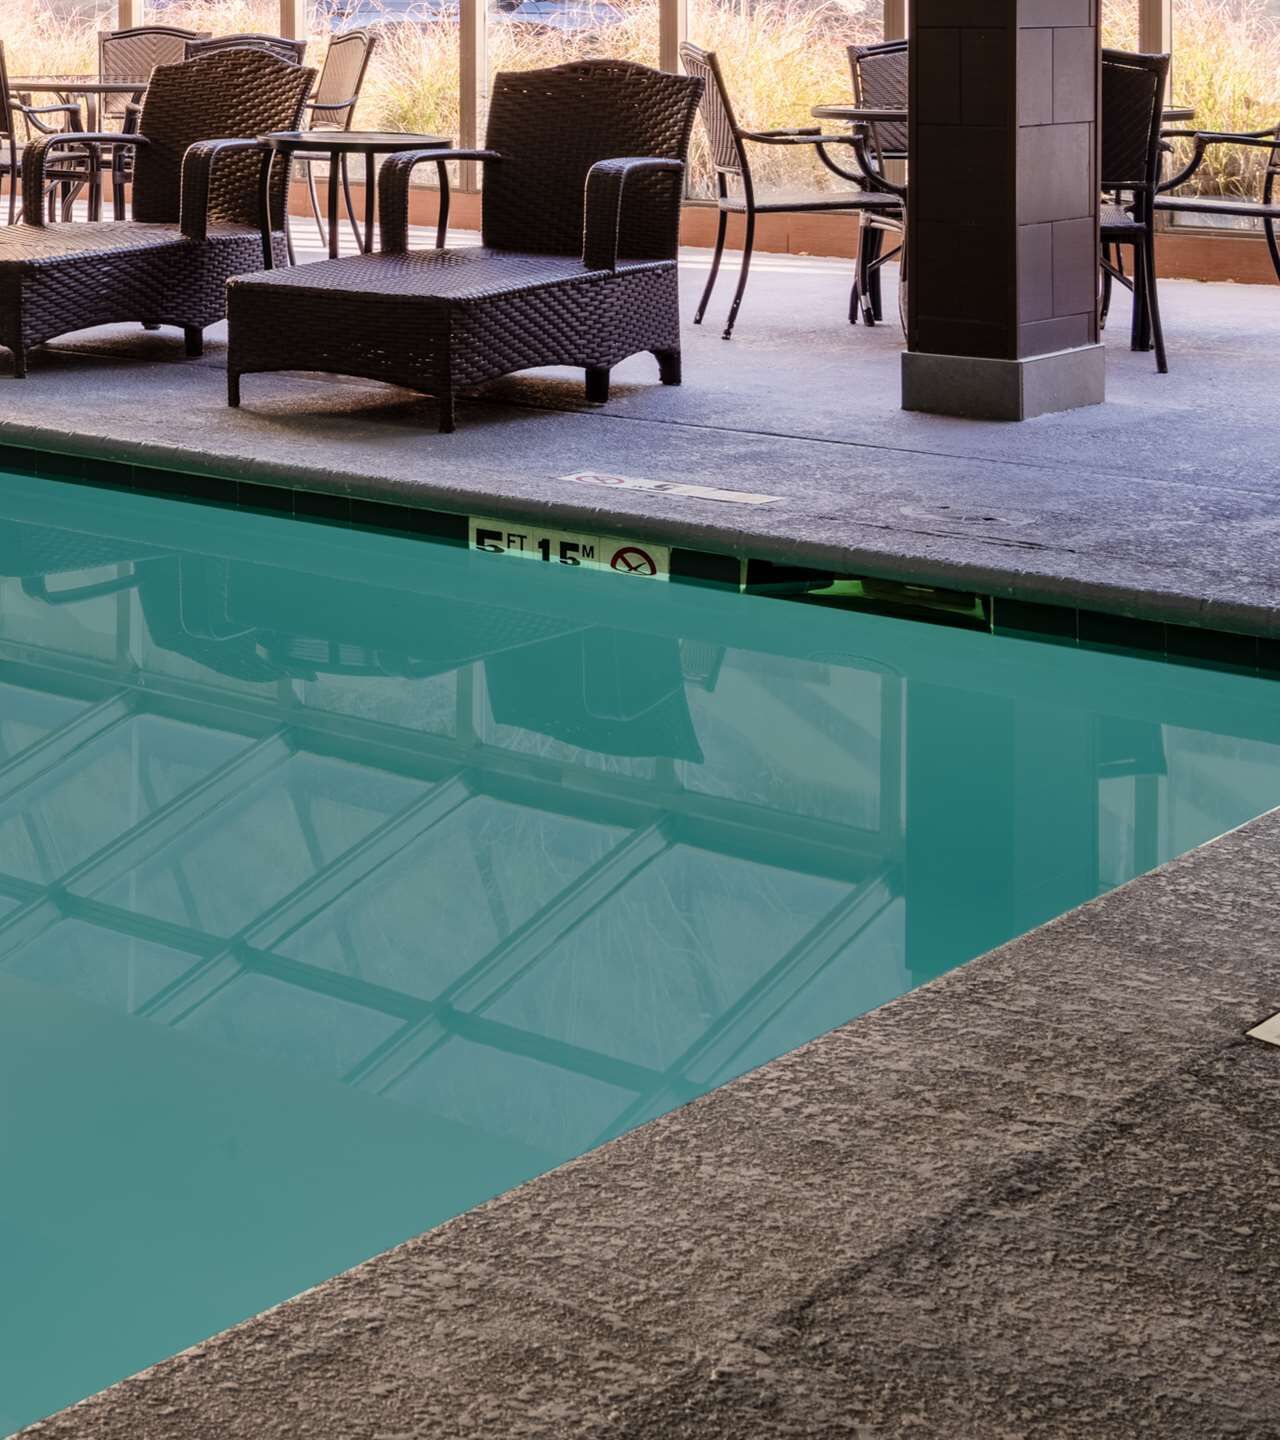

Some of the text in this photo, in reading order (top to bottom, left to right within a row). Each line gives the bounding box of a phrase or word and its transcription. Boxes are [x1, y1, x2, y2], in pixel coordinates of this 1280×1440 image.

[476, 528, 504, 553] 5
[507, 533, 527, 551] FT
[582, 544, 594, 558] M
